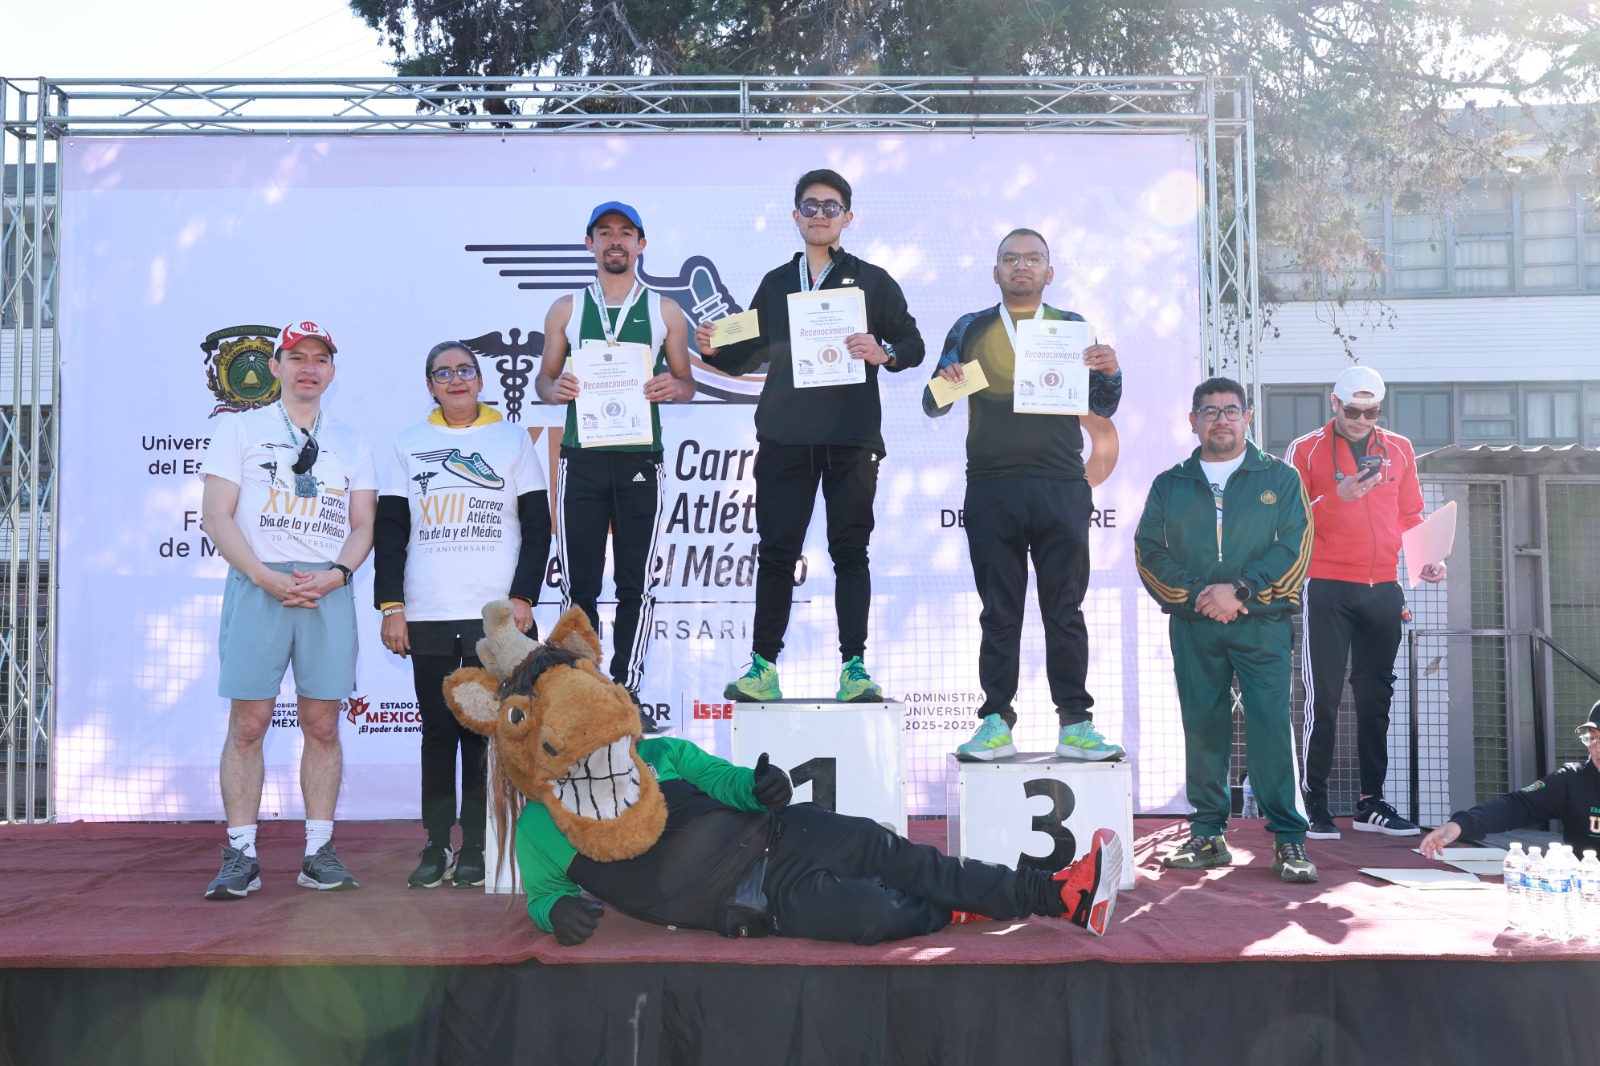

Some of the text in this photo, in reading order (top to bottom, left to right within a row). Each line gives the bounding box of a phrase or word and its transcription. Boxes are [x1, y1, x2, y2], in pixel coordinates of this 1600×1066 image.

[800, 326, 855, 337] Reconocimiento
[1024, 350, 1081, 360] Reconocimiento
[583, 378, 639, 390] Reconocimiento
[610, 404, 618, 415] 2
[142, 434, 212, 451] Univers
[148, 459, 177, 475] del
[675, 439, 757, 481] Carr
[419, 493, 465, 528] XVII
[469, 496, 504, 511] Carrera
[666, 489, 758, 534] Atlét
[260, 515, 345, 539] Día de la y el Médico
[431, 526, 441, 539] de
[442, 526, 451, 538] la
[452, 528, 459, 540] y
[460, 525, 470, 538] el
[471, 525, 502, 539] Médico
[159, 537, 190, 558] de
[436, 545, 495, 553] ANIVERSARIO
[682, 543, 808, 588] Médo
[380, 702, 413, 710] ESTADO
[694, 700, 733, 720] isse
[272, 716, 299, 728] MÉXI
[365, 711, 423, 724] MÉXICO
[905, 720, 976, 730] 2025-2029
[358, 725, 422, 735] ¡El poder de servi
[789, 757, 836, 813] 1
[1017, 778, 1076, 872] 3
